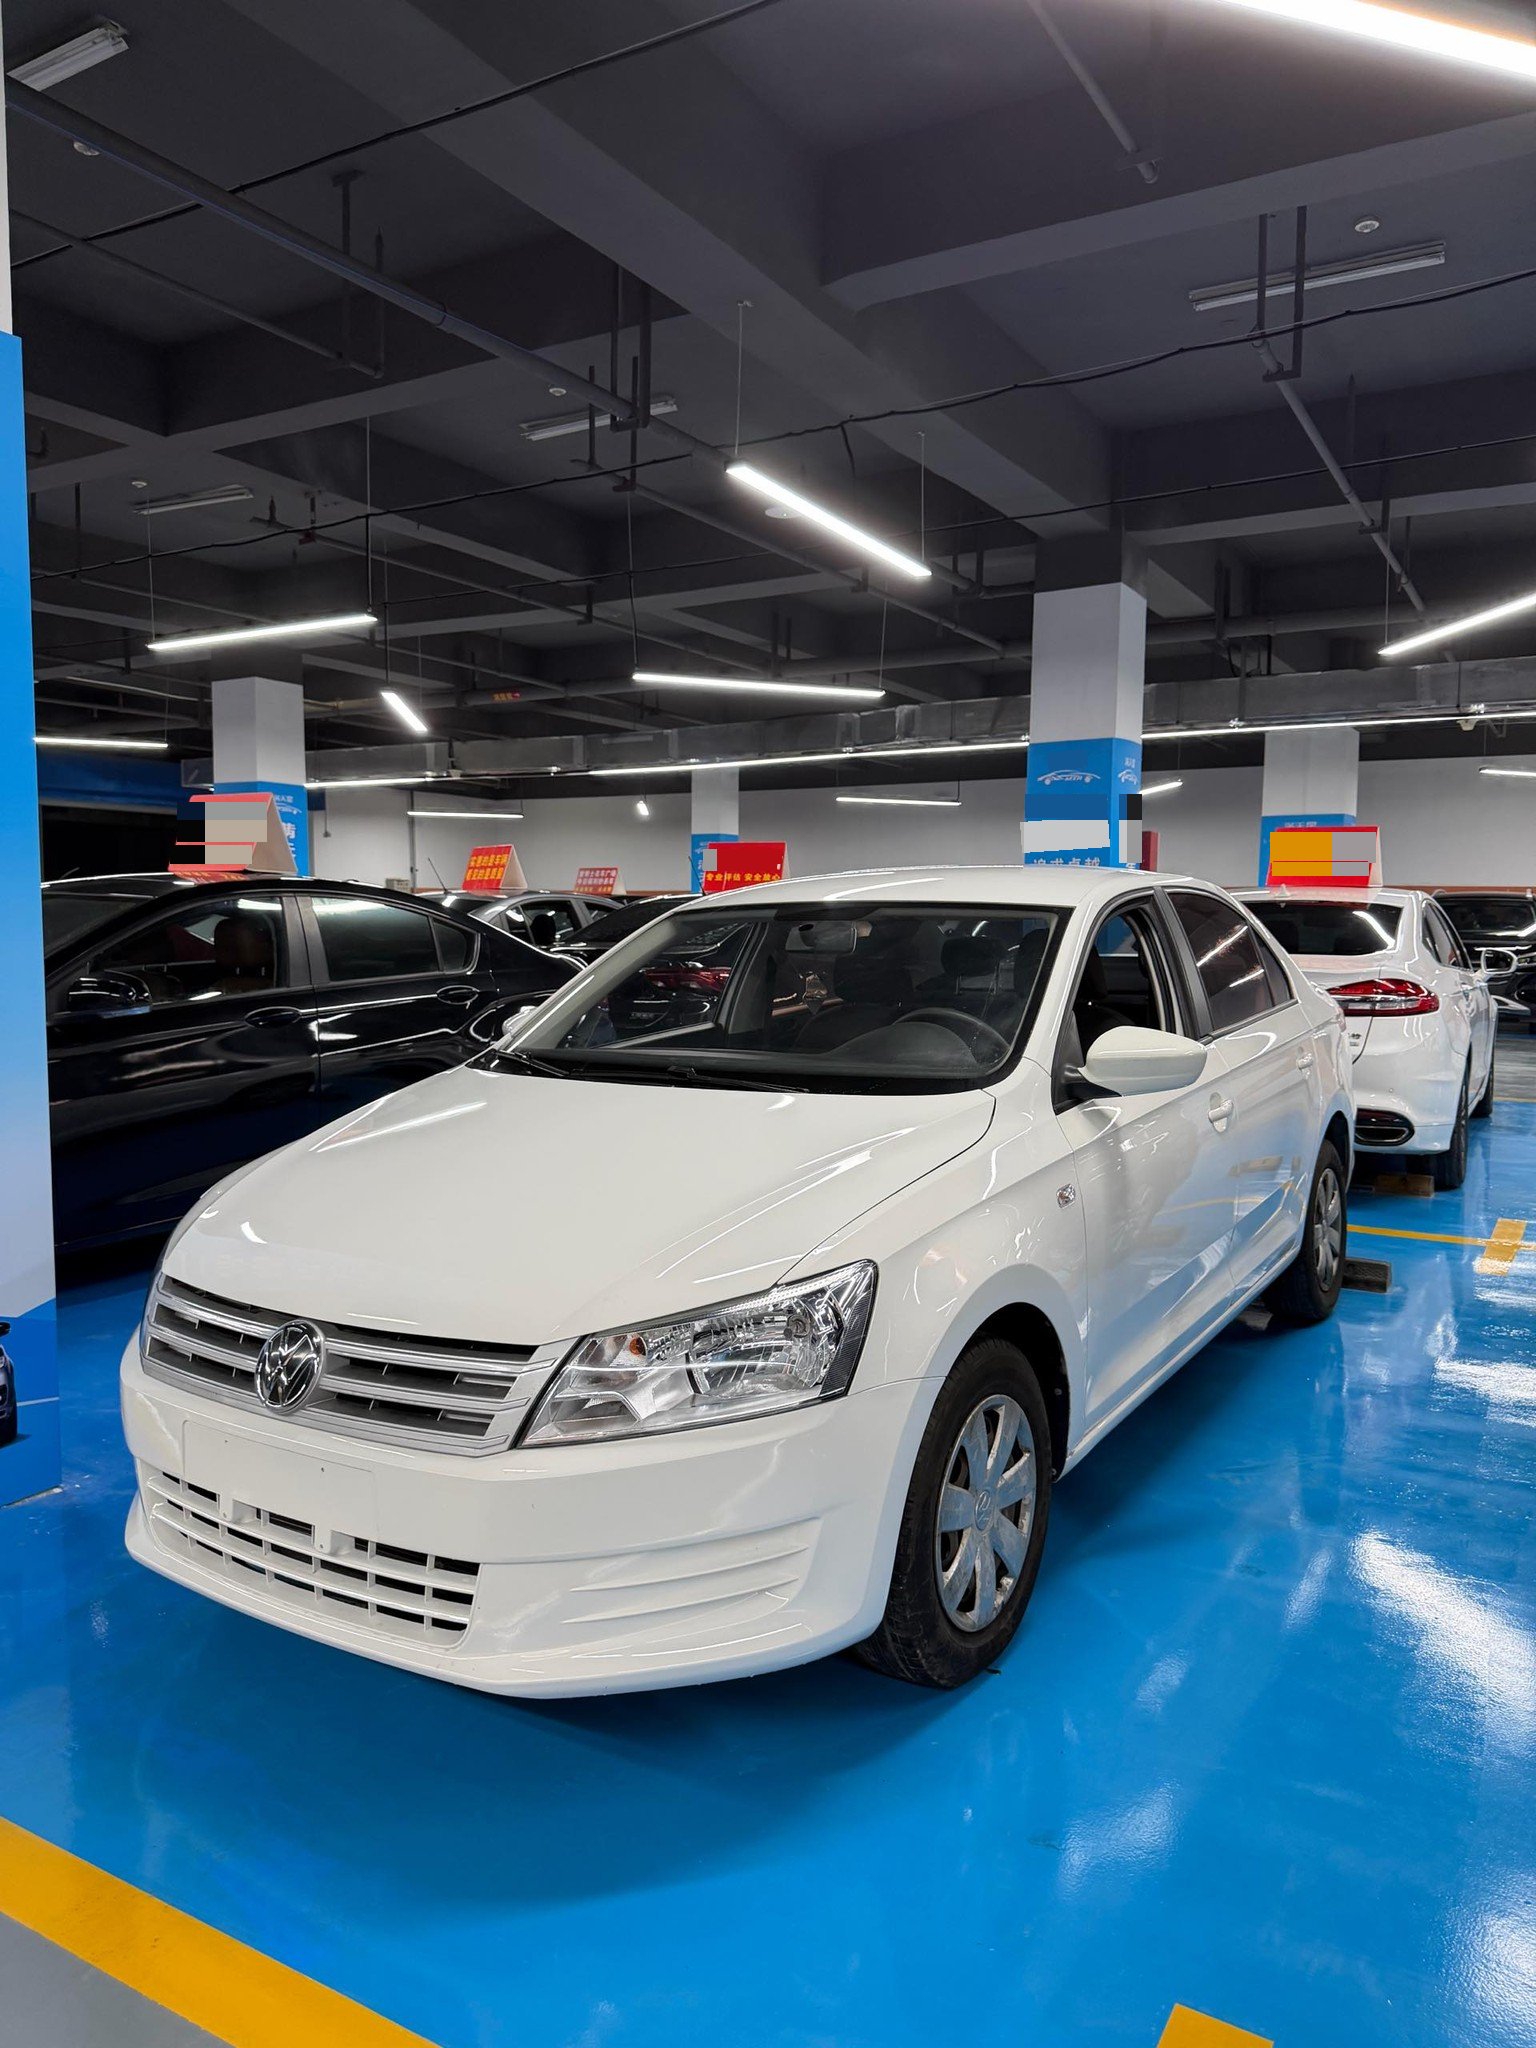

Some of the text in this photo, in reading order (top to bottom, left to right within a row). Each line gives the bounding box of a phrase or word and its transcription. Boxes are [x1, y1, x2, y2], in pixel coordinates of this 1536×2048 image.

[706, 873, 781, 882] 专业评估 安全放心
